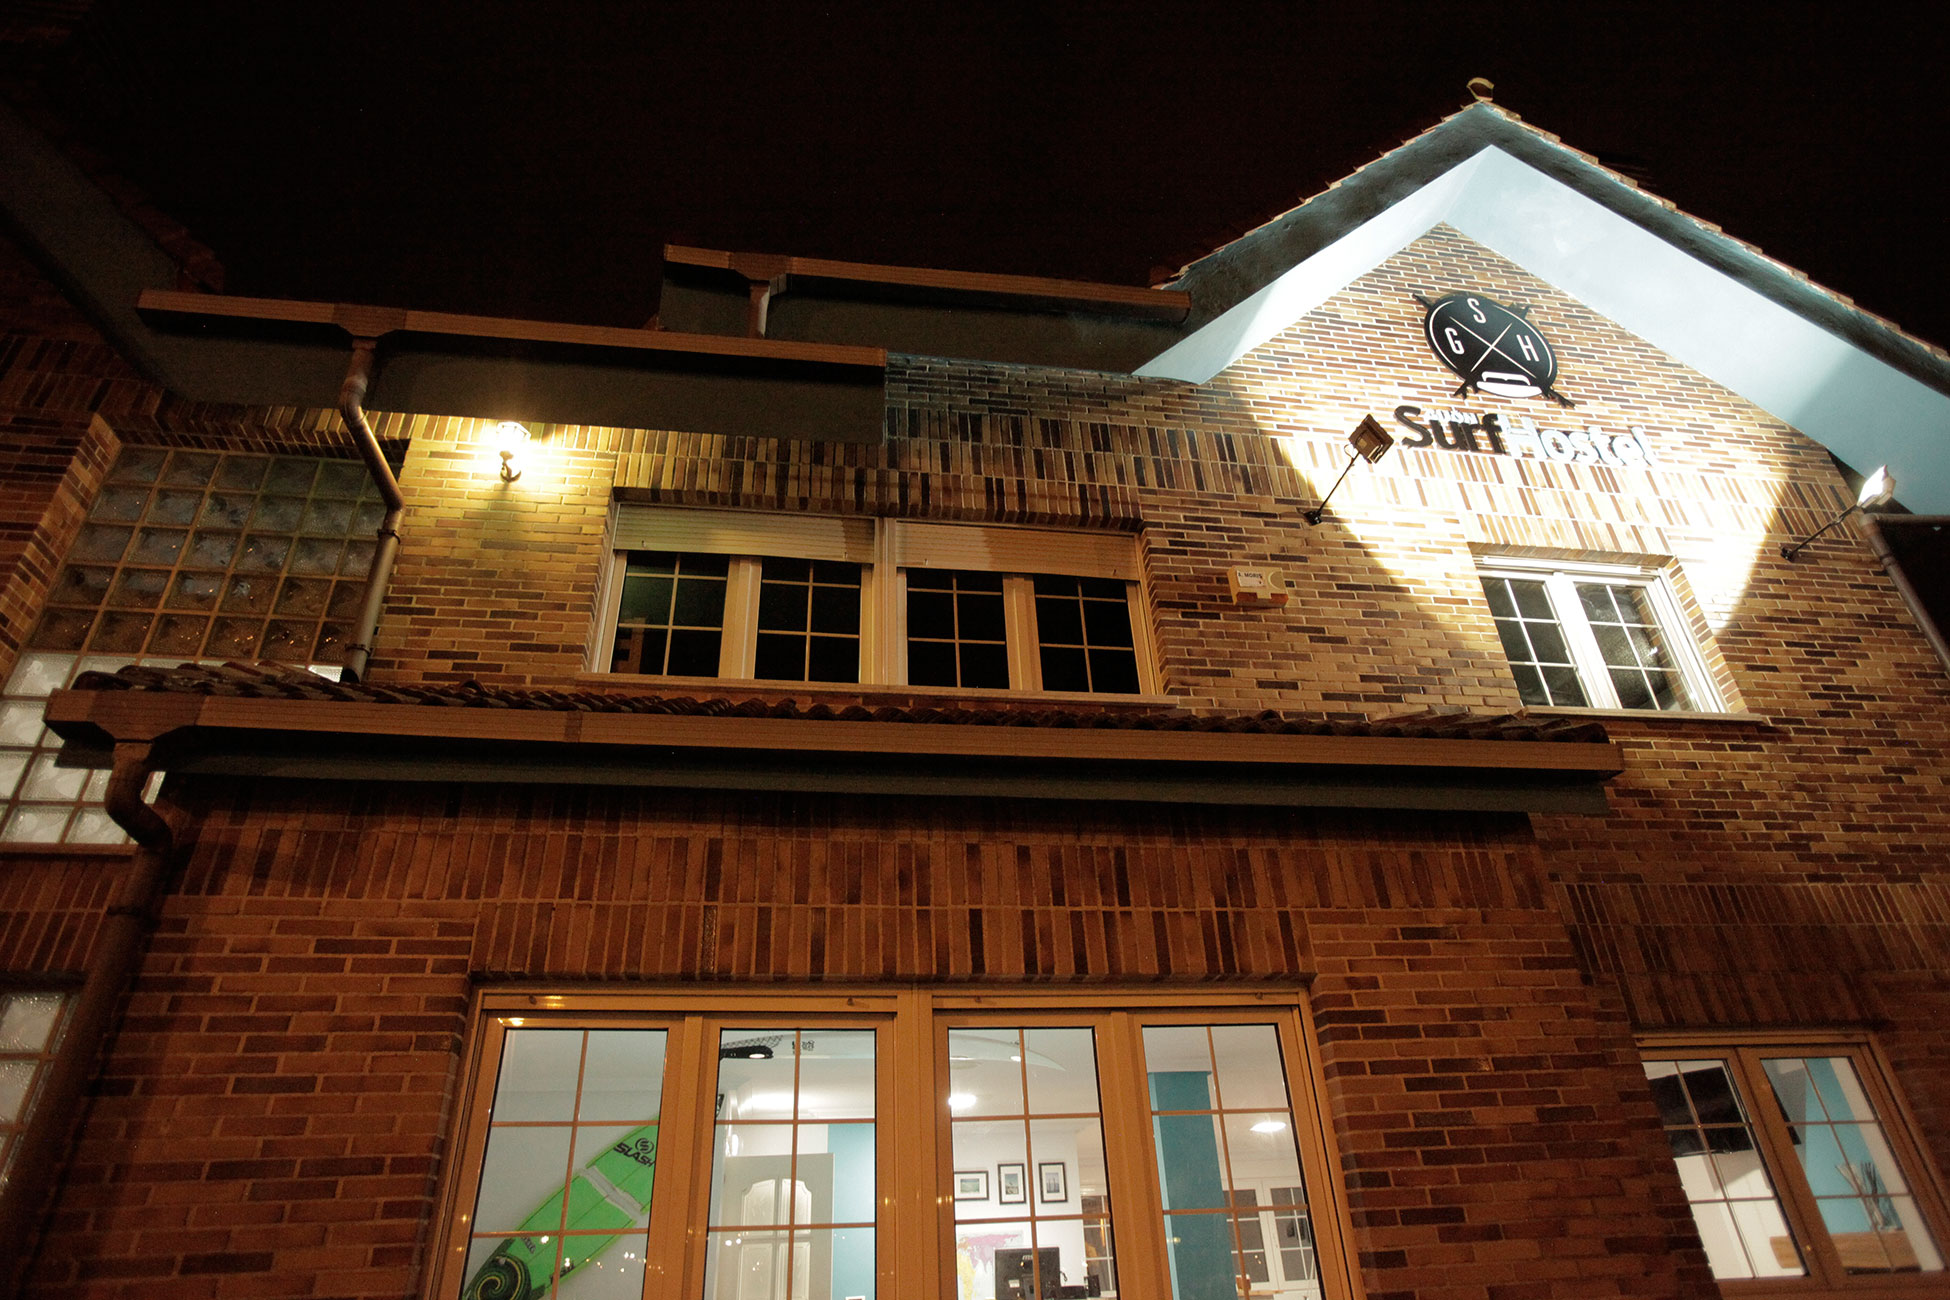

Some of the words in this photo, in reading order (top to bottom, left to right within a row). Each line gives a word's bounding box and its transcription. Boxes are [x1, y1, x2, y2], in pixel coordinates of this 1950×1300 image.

[1467, 298, 1486, 324] S
[1445, 327, 1465, 355] G
[1516, 334, 1540, 362] H
